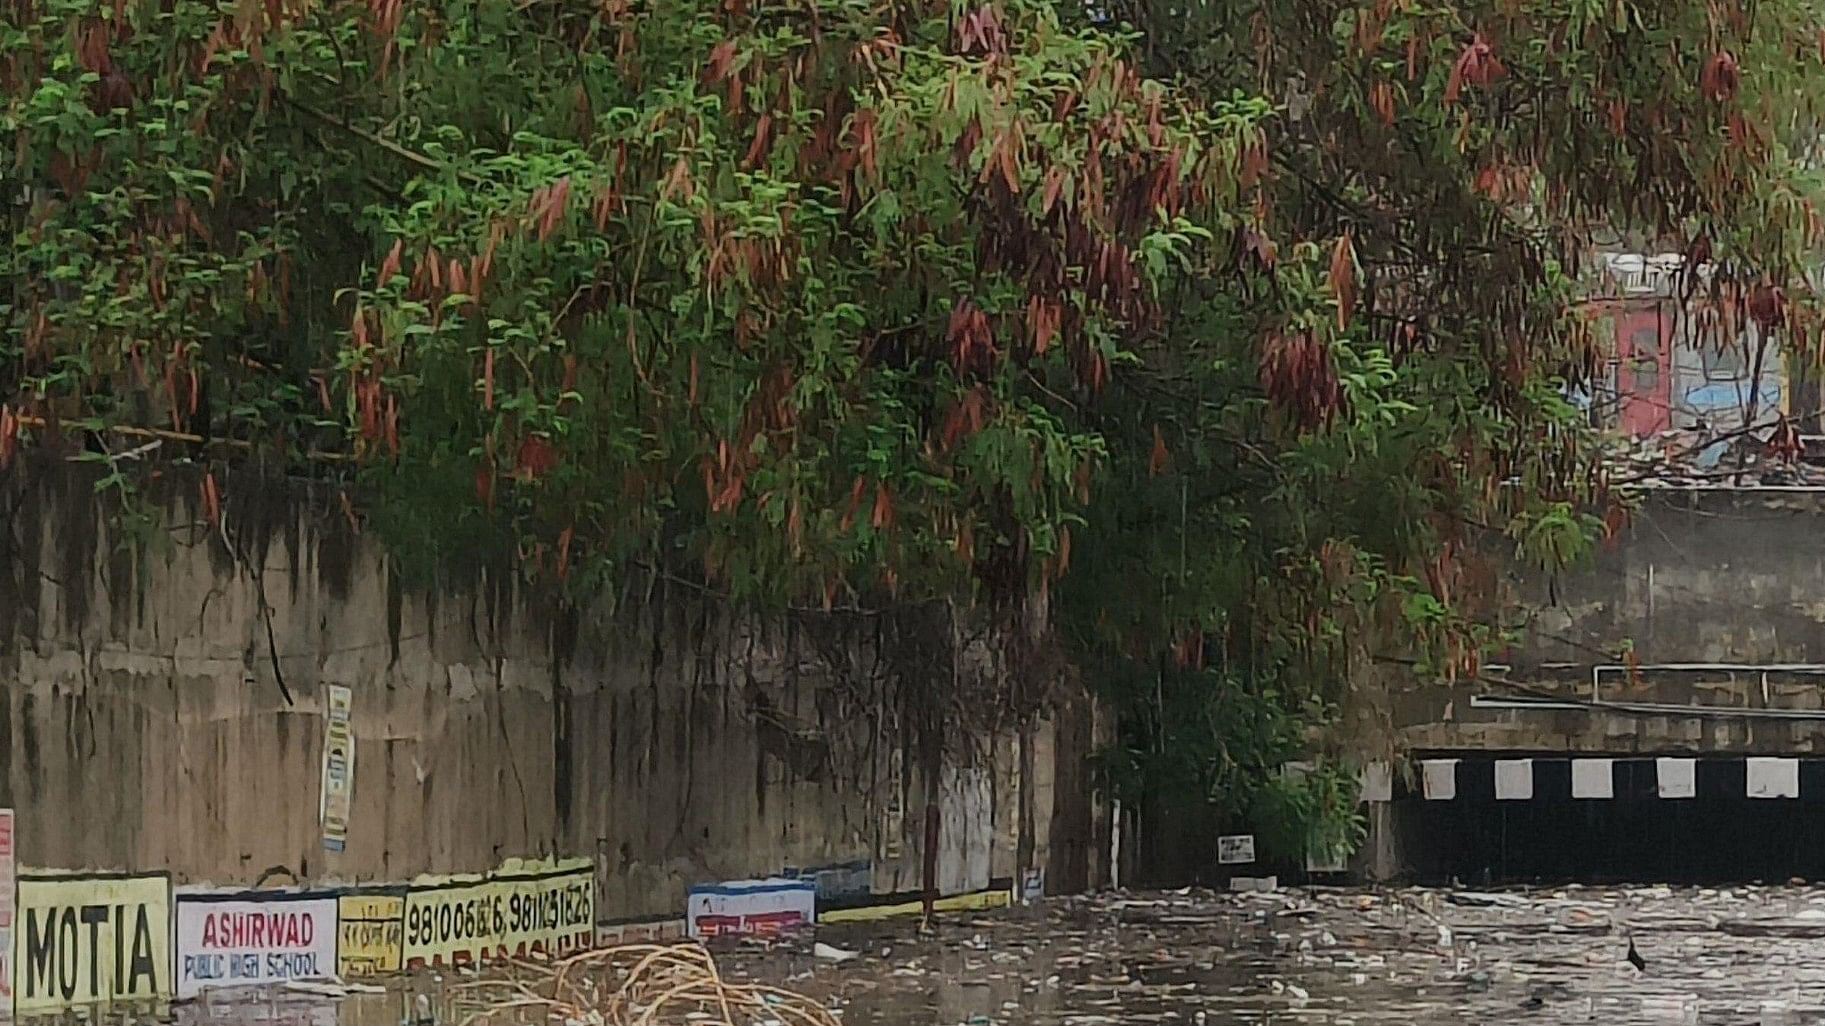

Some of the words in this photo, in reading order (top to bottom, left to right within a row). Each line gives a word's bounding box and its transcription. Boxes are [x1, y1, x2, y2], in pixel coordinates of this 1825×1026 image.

[202, 912, 314, 949] ASHIRWAD
[26, 903, 157, 1000] MOTIA
[184, 953, 225, 981] PUBLIC
[267, 951, 321, 977] SCHOOL
